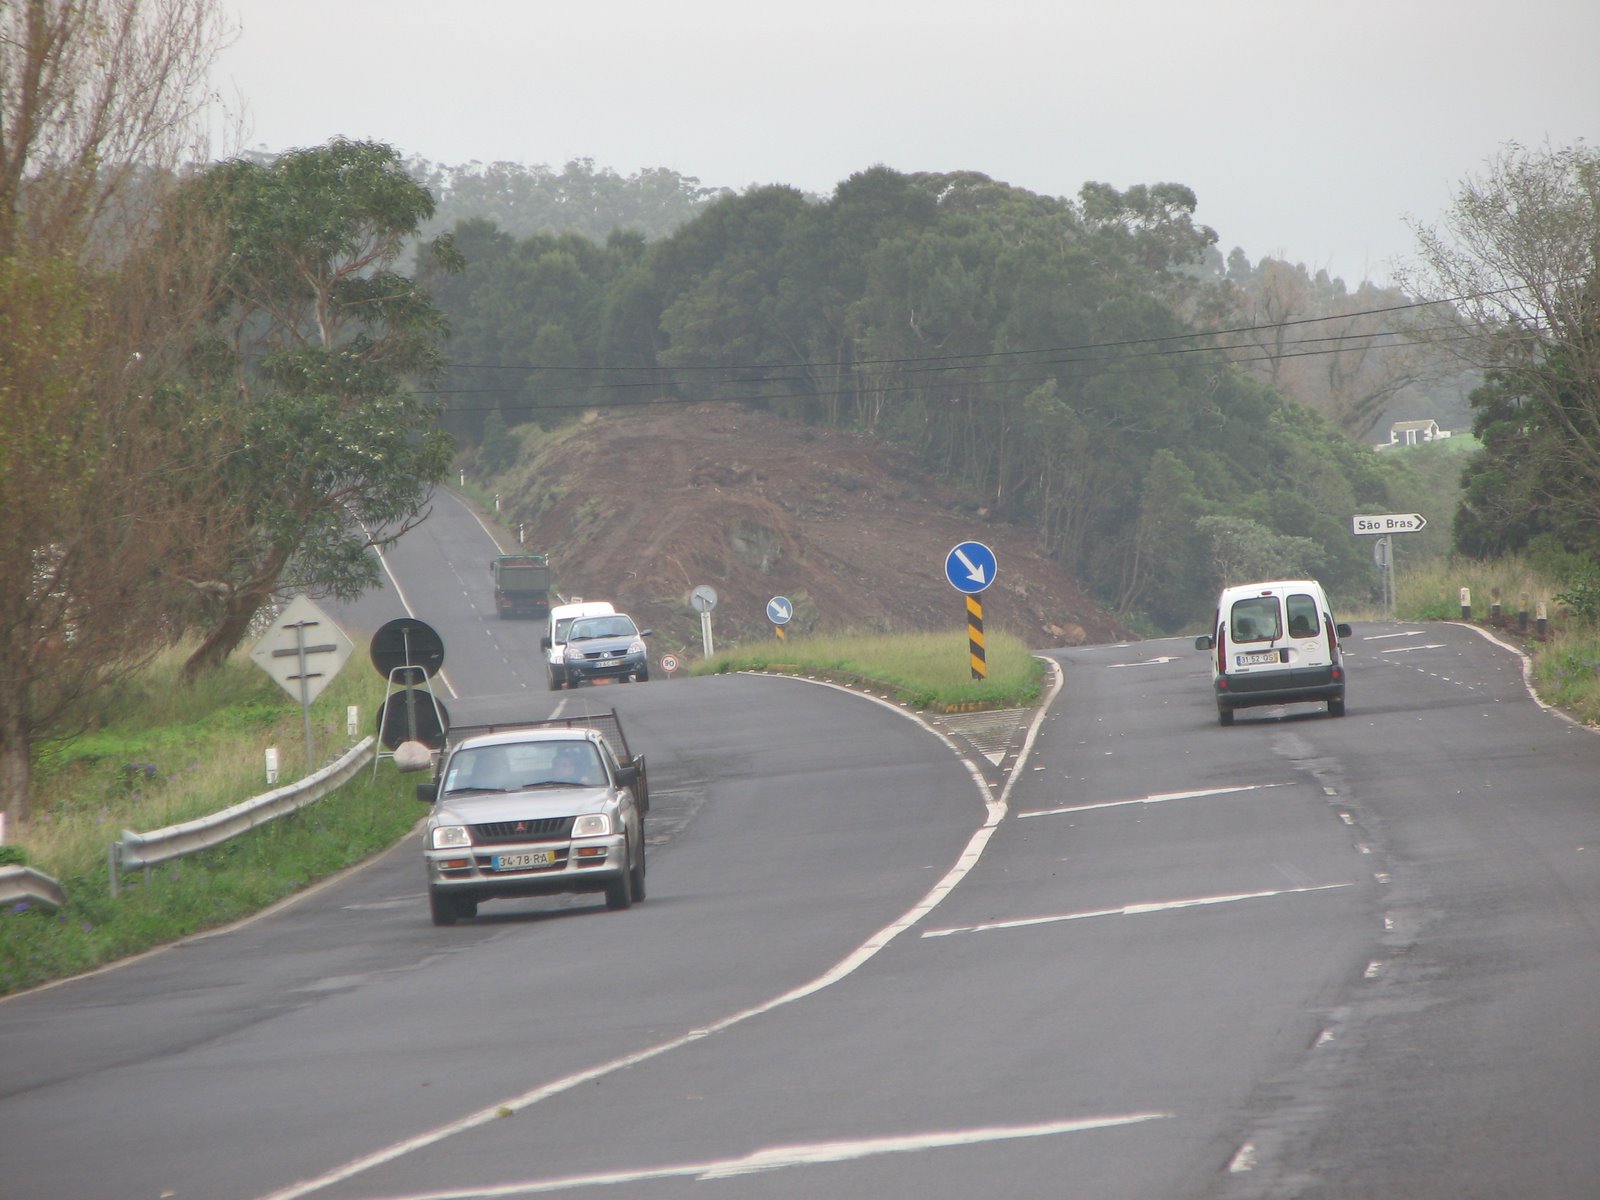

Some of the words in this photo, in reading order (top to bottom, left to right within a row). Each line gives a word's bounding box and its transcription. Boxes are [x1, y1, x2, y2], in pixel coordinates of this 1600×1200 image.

[1358, 520, 1381, 530] São
[1386, 519, 1414, 529] Bras
[664, 659, 674, 667] 90
